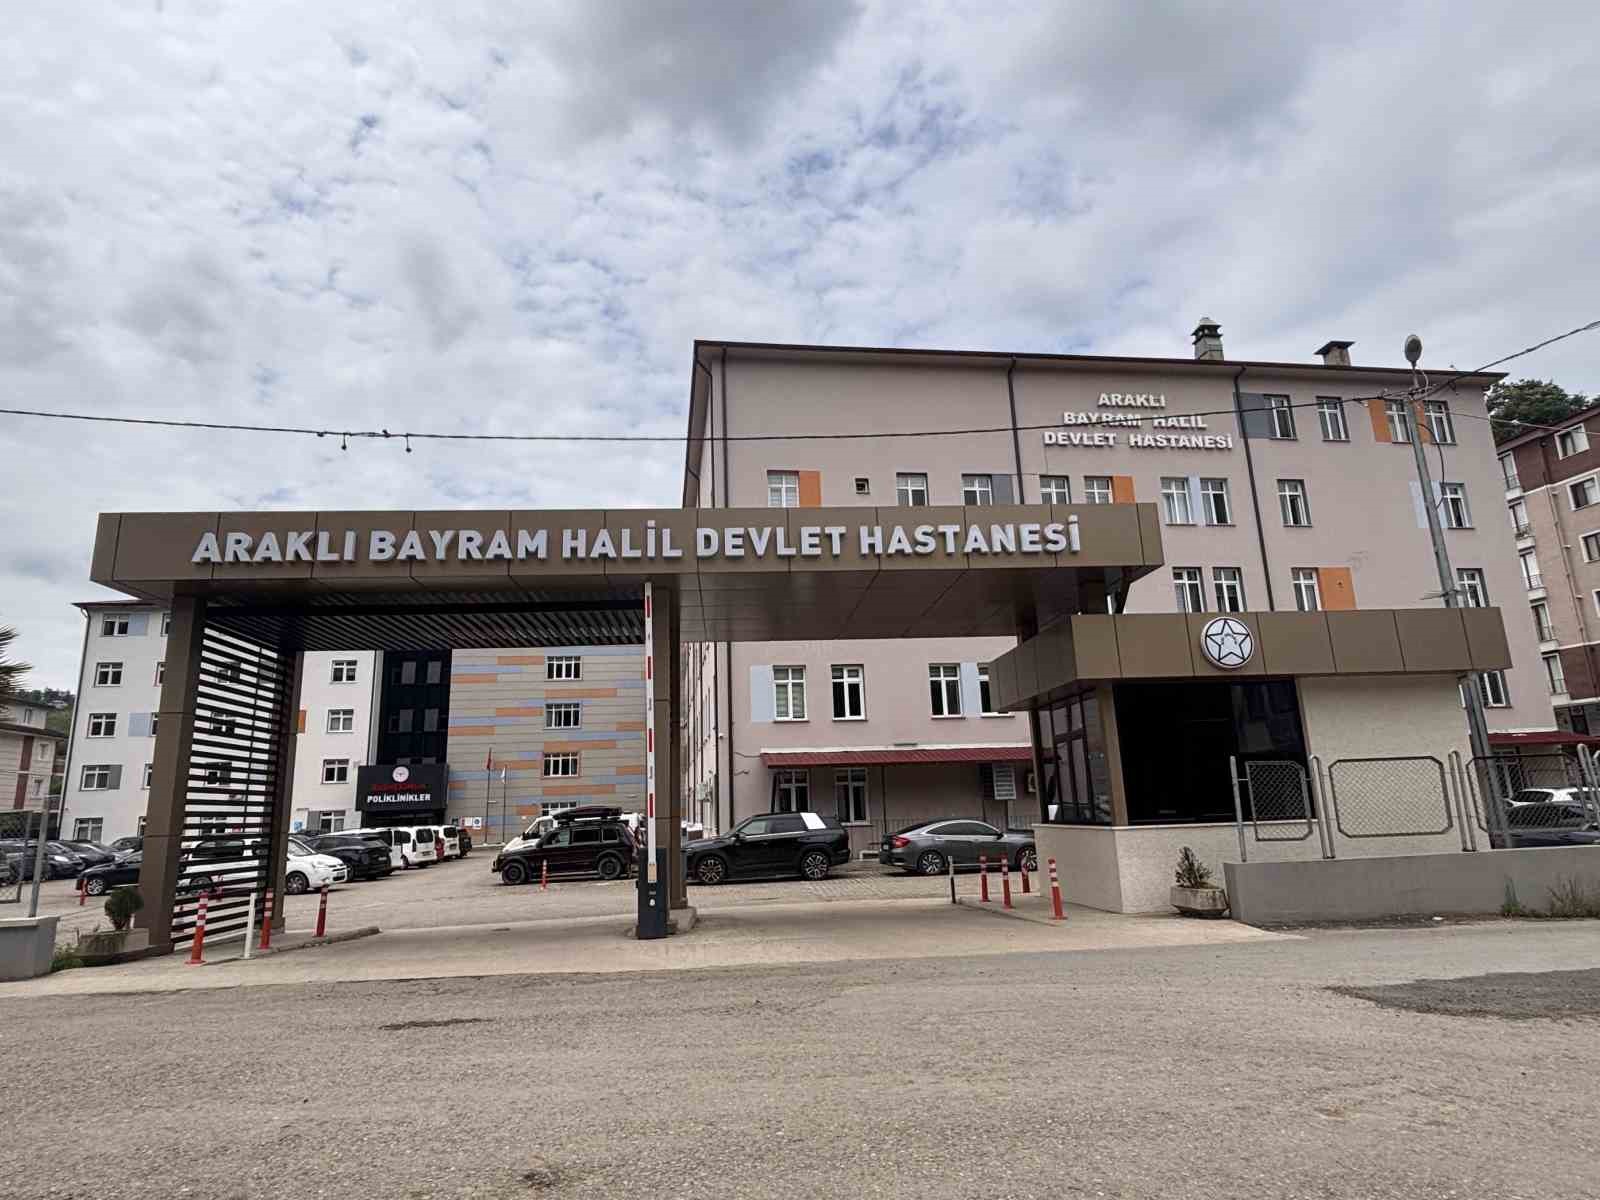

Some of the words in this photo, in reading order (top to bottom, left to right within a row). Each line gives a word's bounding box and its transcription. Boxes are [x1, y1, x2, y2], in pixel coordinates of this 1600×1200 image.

[1098, 393, 1166, 408] ARAKLI
[1063, 412, 1142, 427] BAYRAM
[1044, 431, 1116, 446] DEVLET
[1129, 433, 1233, 449] HASTANESİ
[191, 530, 356, 563] ARAKLI
[368, 529, 548, 561] BAYRAM
[562, 520, 683, 559] HALİL
[696, 526, 846, 557] DEVLET
[859, 514, 1081, 555] HASTANESİ
